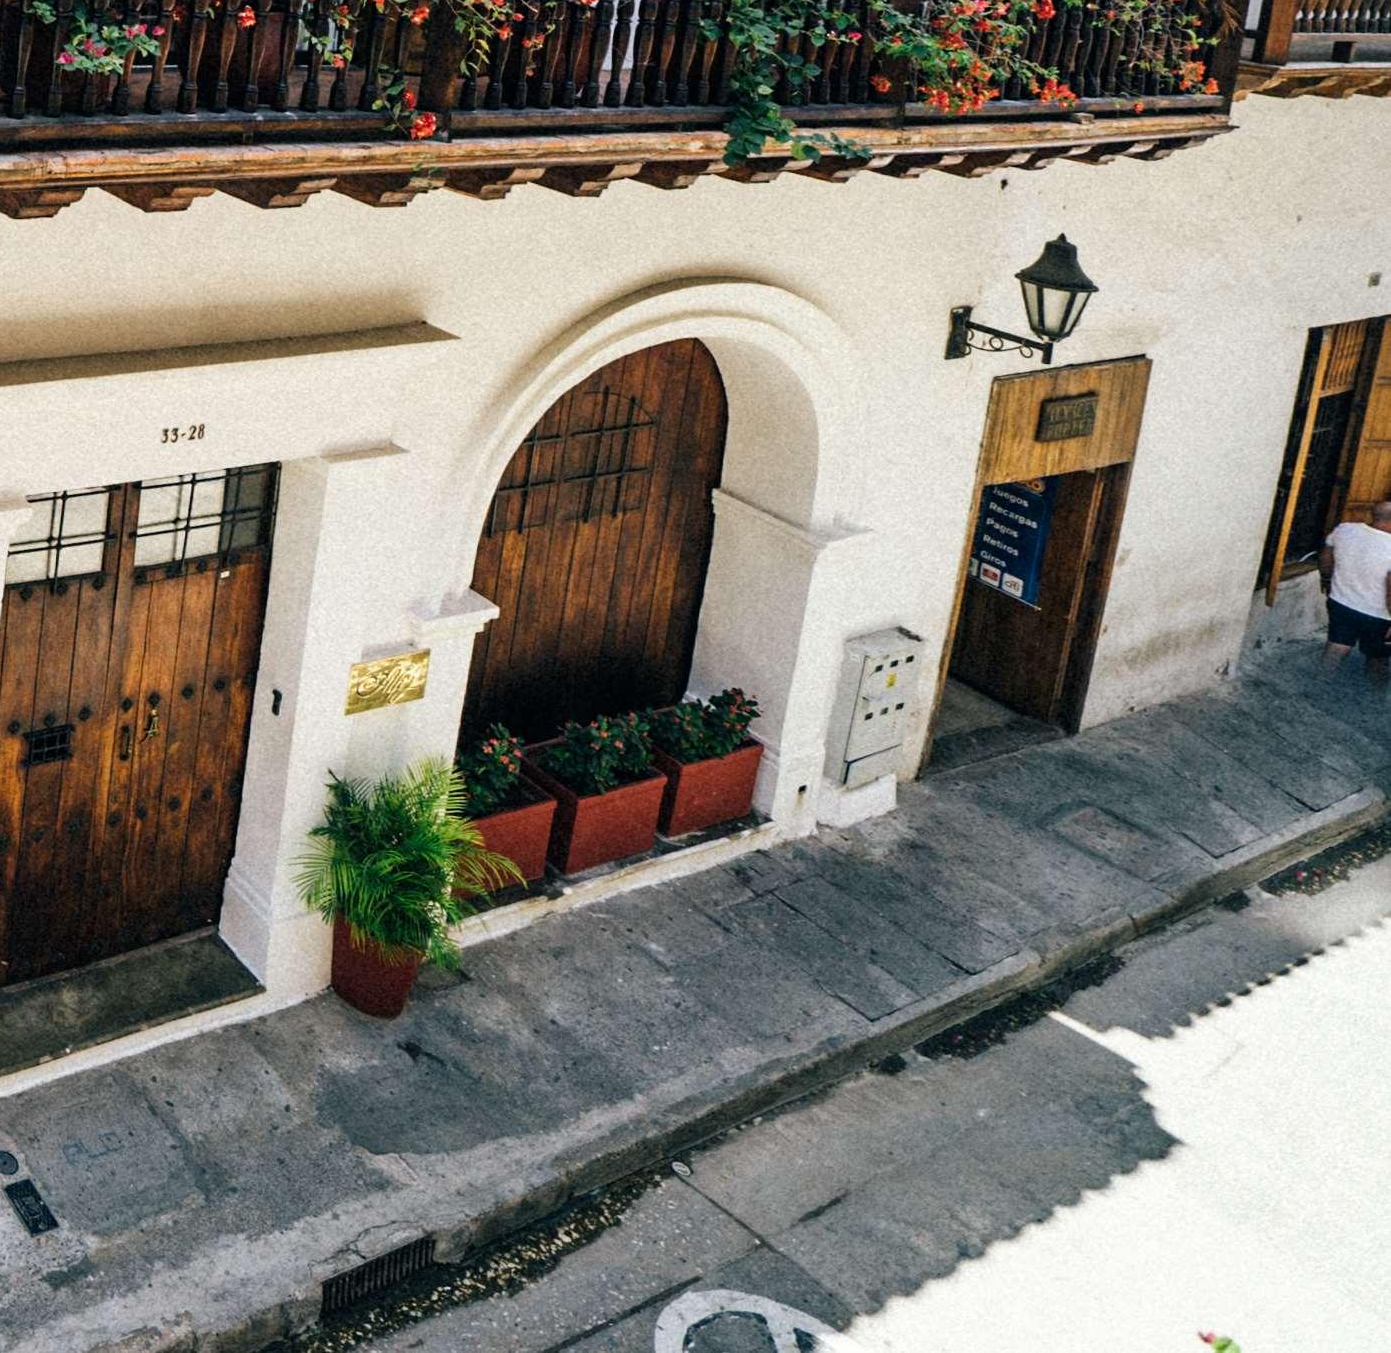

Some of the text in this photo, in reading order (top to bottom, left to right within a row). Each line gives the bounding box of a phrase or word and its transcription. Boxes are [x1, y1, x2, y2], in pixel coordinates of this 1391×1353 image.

[161, 423, 206, 444] 33-28
[992, 487, 1029, 507] Juegos
[989, 501, 1038, 529] Recargas
[986, 517, 1019, 538] Pagos
[983, 534, 1019, 556] Retiros
[980, 550, 1007, 568] Giros
